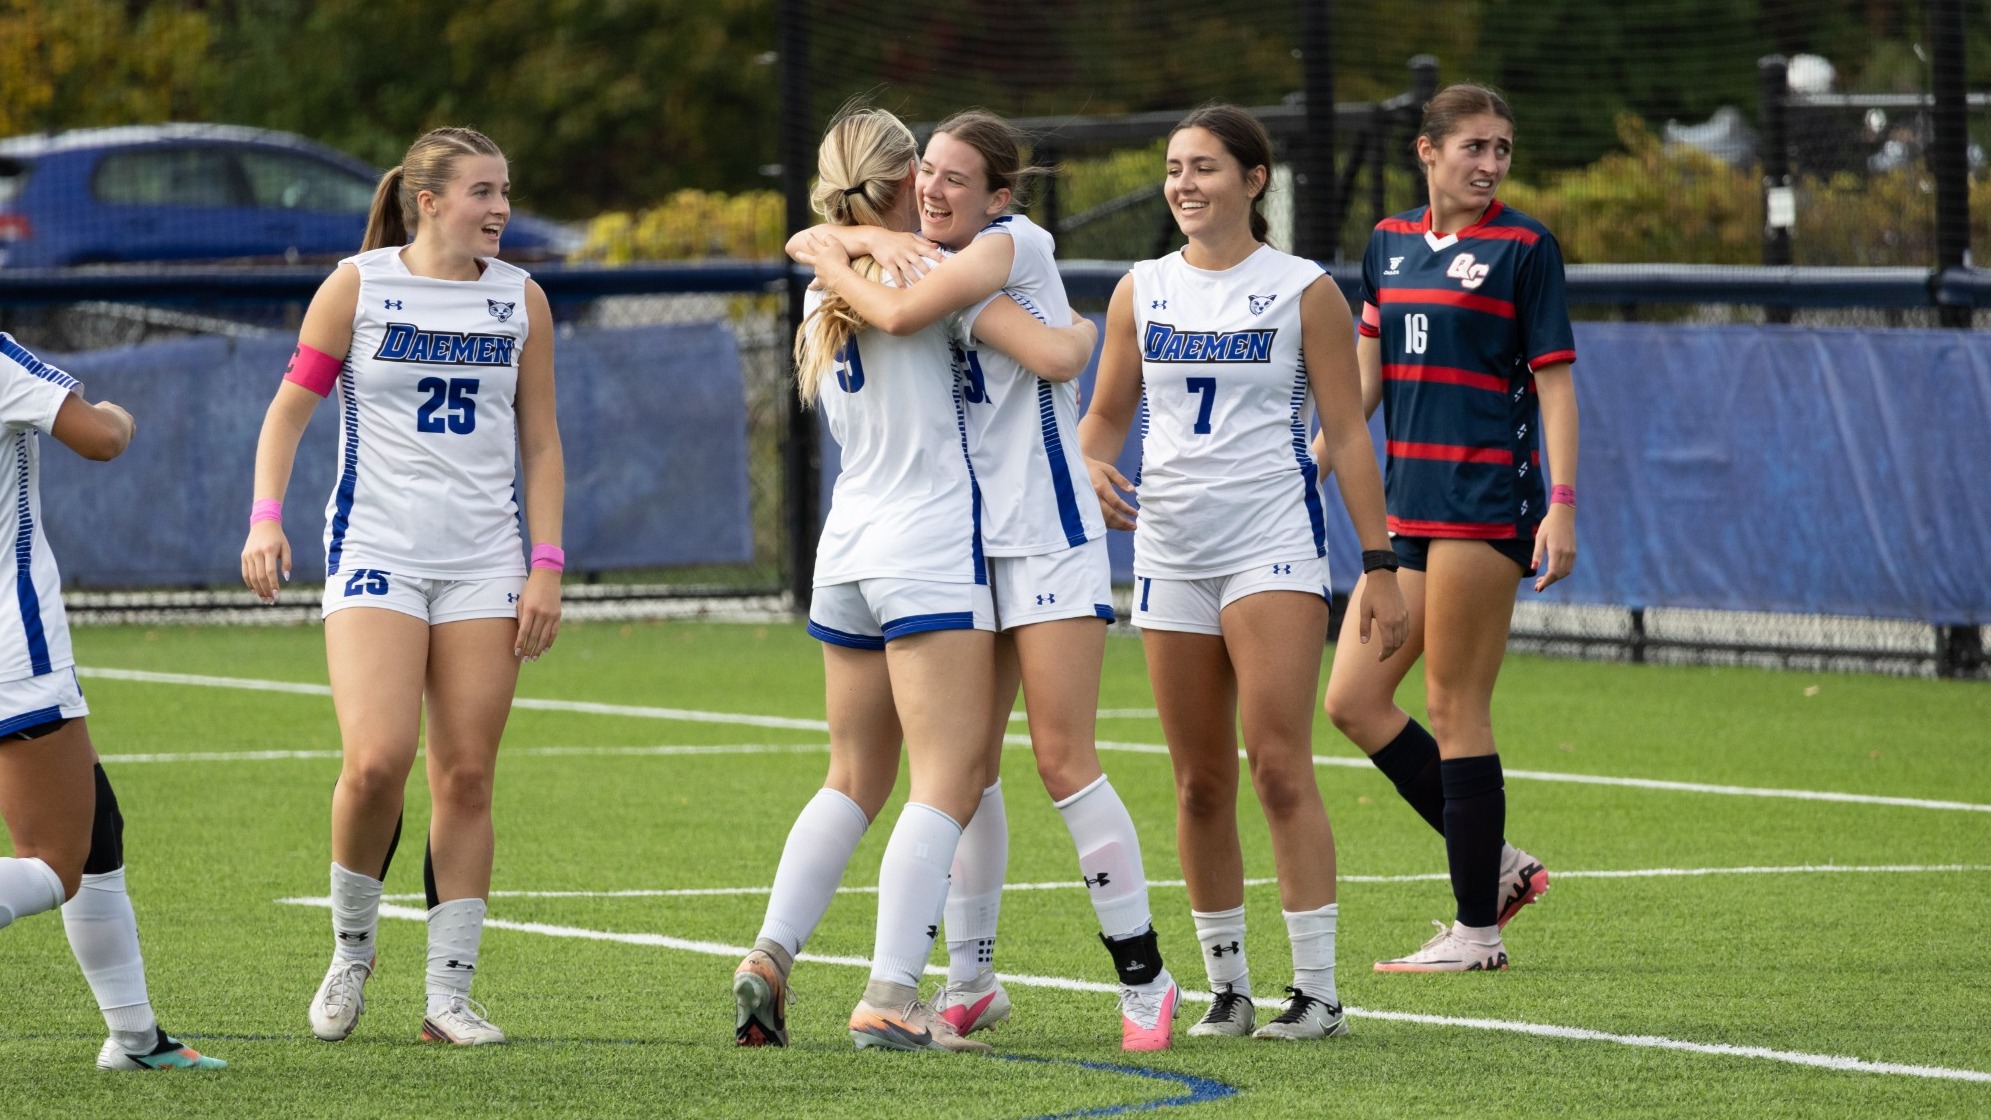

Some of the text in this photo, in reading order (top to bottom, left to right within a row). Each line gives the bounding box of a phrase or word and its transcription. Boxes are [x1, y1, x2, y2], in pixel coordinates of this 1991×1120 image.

[374, 322, 516, 367] DAEMEN
[1144, 321, 1278, 363] DAEMEN
[1404, 313, 1429, 354] 16
[417, 376, 480, 435] 25
[1186, 377, 1216, 434] 7
[343, 568, 391, 597] 25
